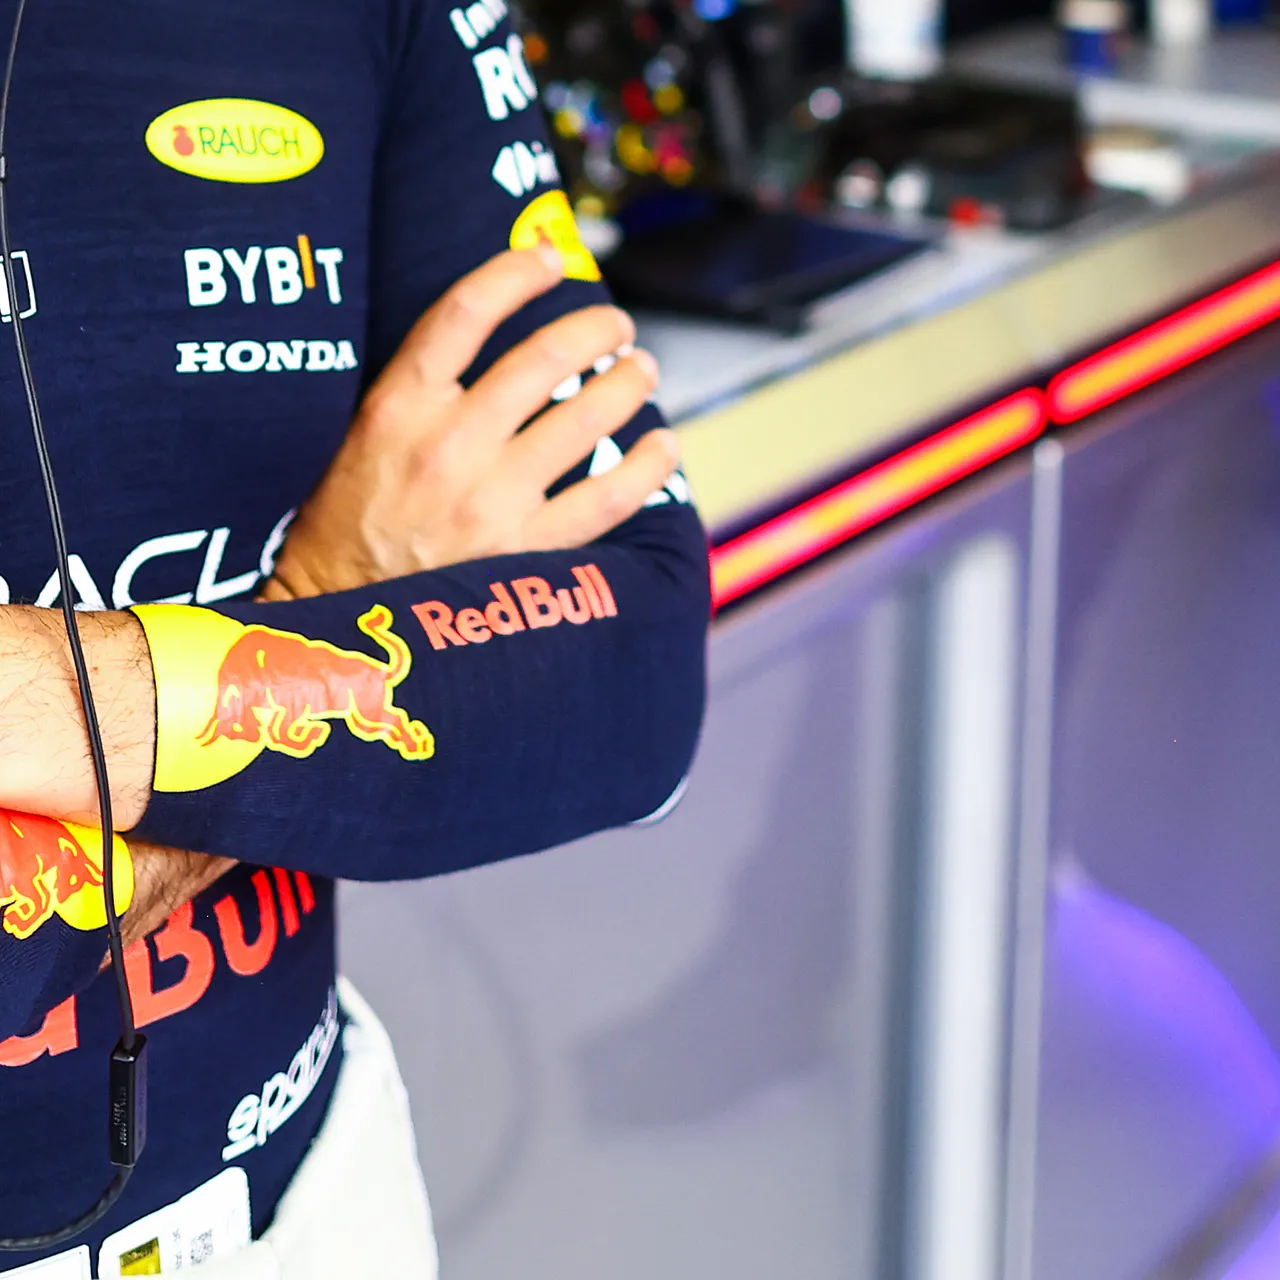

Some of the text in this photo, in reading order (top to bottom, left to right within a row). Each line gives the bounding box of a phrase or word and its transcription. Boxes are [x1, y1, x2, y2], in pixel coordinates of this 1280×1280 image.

[198, 126, 303, 159] RAUCH
[183, 234, 344, 308] BYBIT
[175, 339, 359, 373] HONDA
[411, 563, 619, 650] Red Bull
